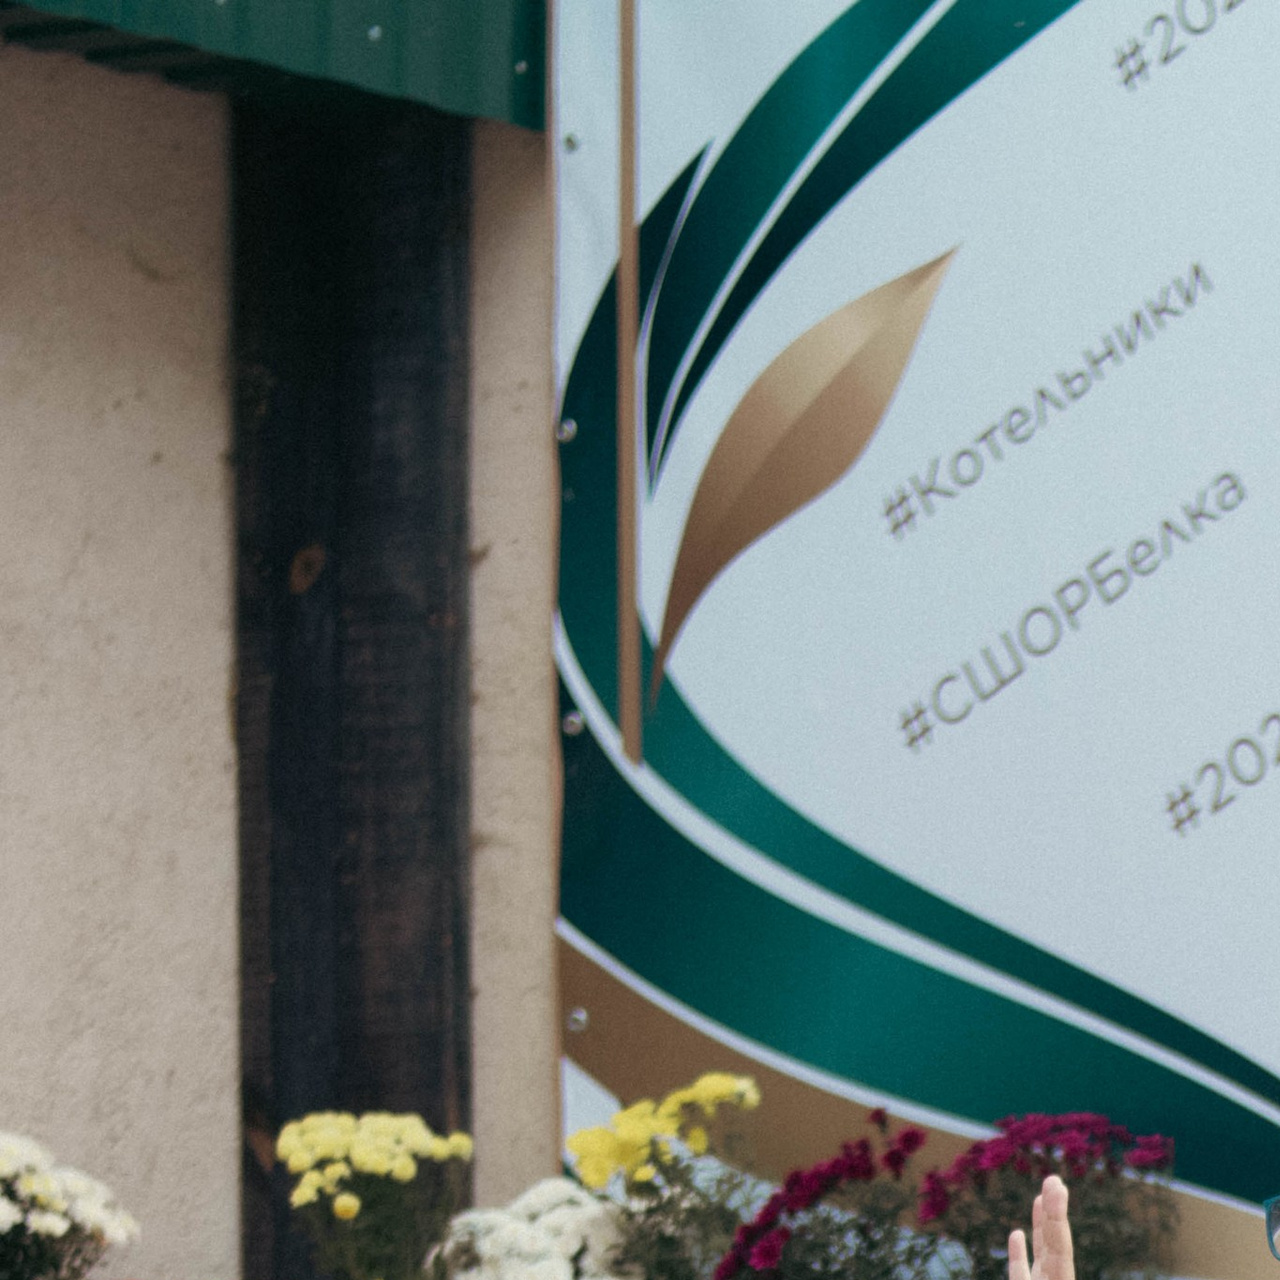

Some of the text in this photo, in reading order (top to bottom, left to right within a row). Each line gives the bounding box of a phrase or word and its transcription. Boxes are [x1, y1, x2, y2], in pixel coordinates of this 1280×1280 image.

[1113, 0, 1245, 91] #20
[882, 262, 1214, 541] #Котельники
[899, 471, 1248, 754] #СШОРБелка
